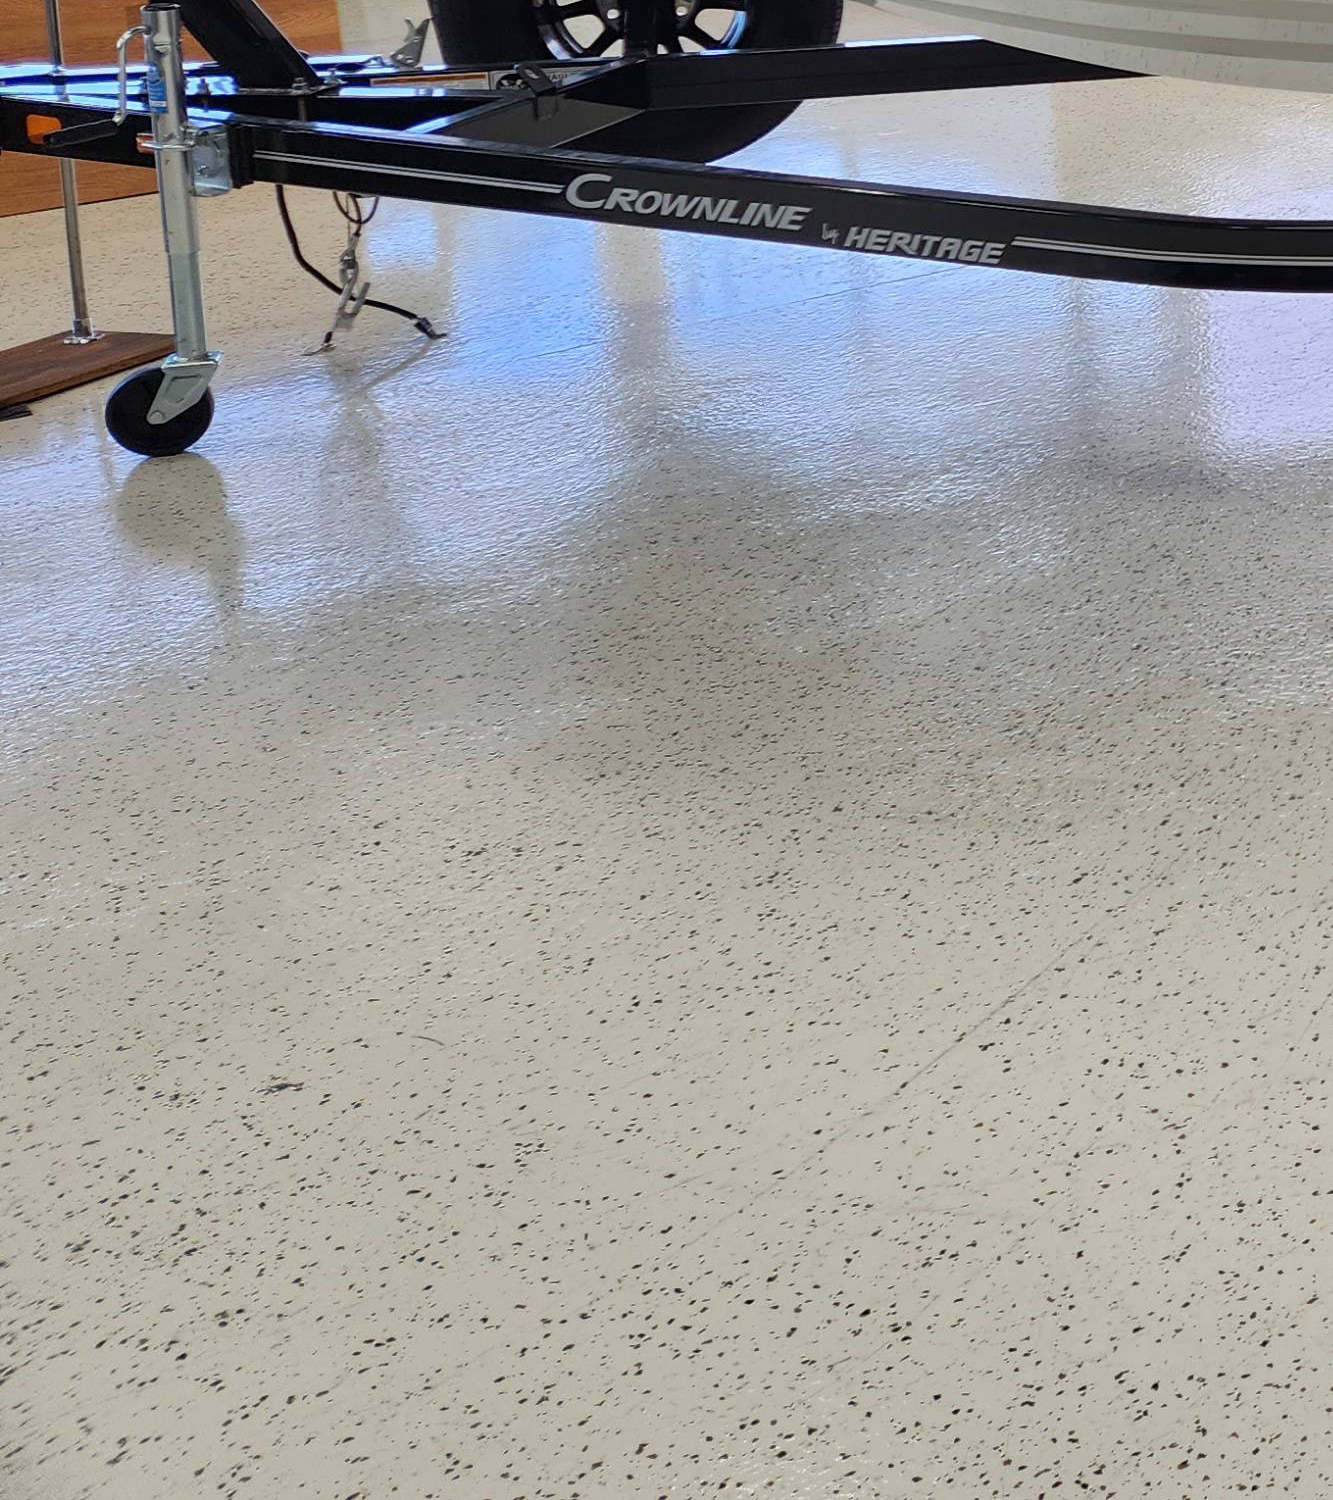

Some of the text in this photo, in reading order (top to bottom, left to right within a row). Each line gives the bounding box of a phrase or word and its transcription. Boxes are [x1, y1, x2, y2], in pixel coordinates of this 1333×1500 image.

[565, 172, 1006, 266] CROWNLINE by HERITAGE
